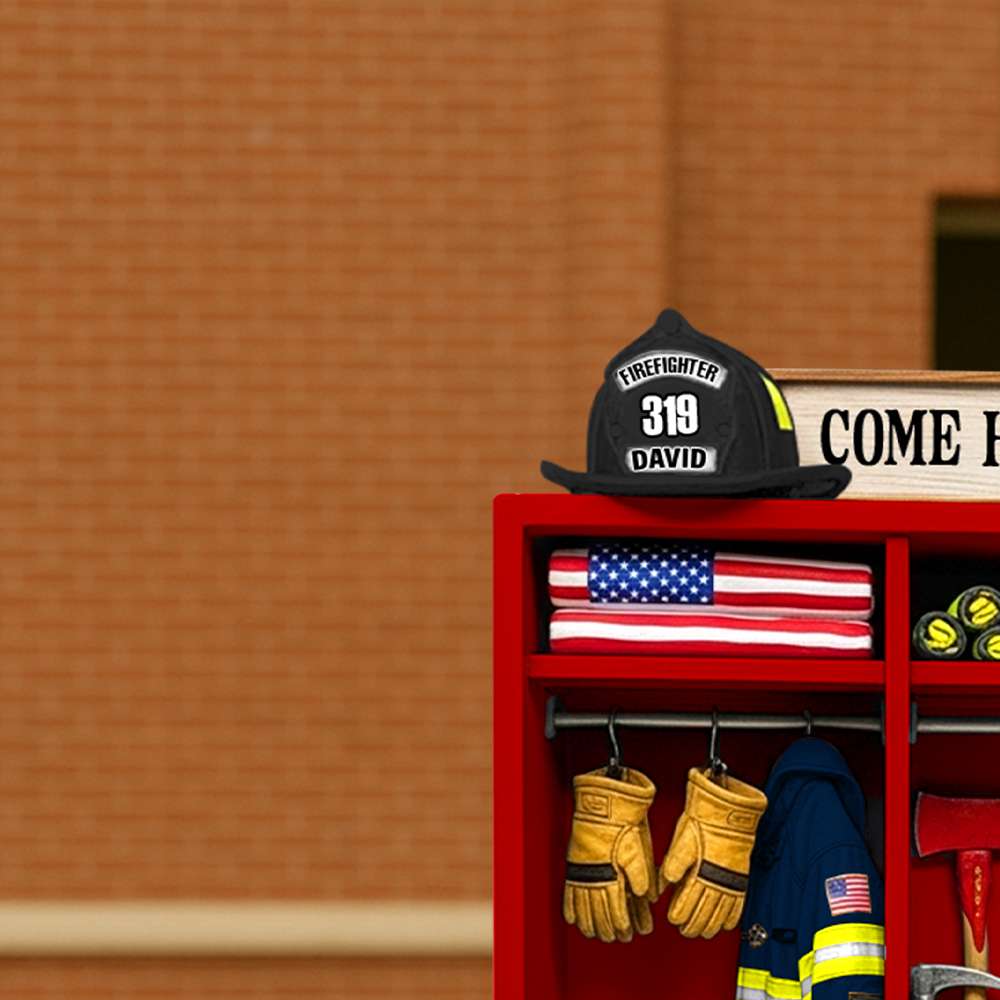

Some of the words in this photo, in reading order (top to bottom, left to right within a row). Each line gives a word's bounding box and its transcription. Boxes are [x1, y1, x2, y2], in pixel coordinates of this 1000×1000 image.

[618, 356, 719, 385] FIREFIGHTER
[642, 393, 699, 437] 319
[821, 408, 961, 466] COME
[631, 448, 707, 472] DAVID
